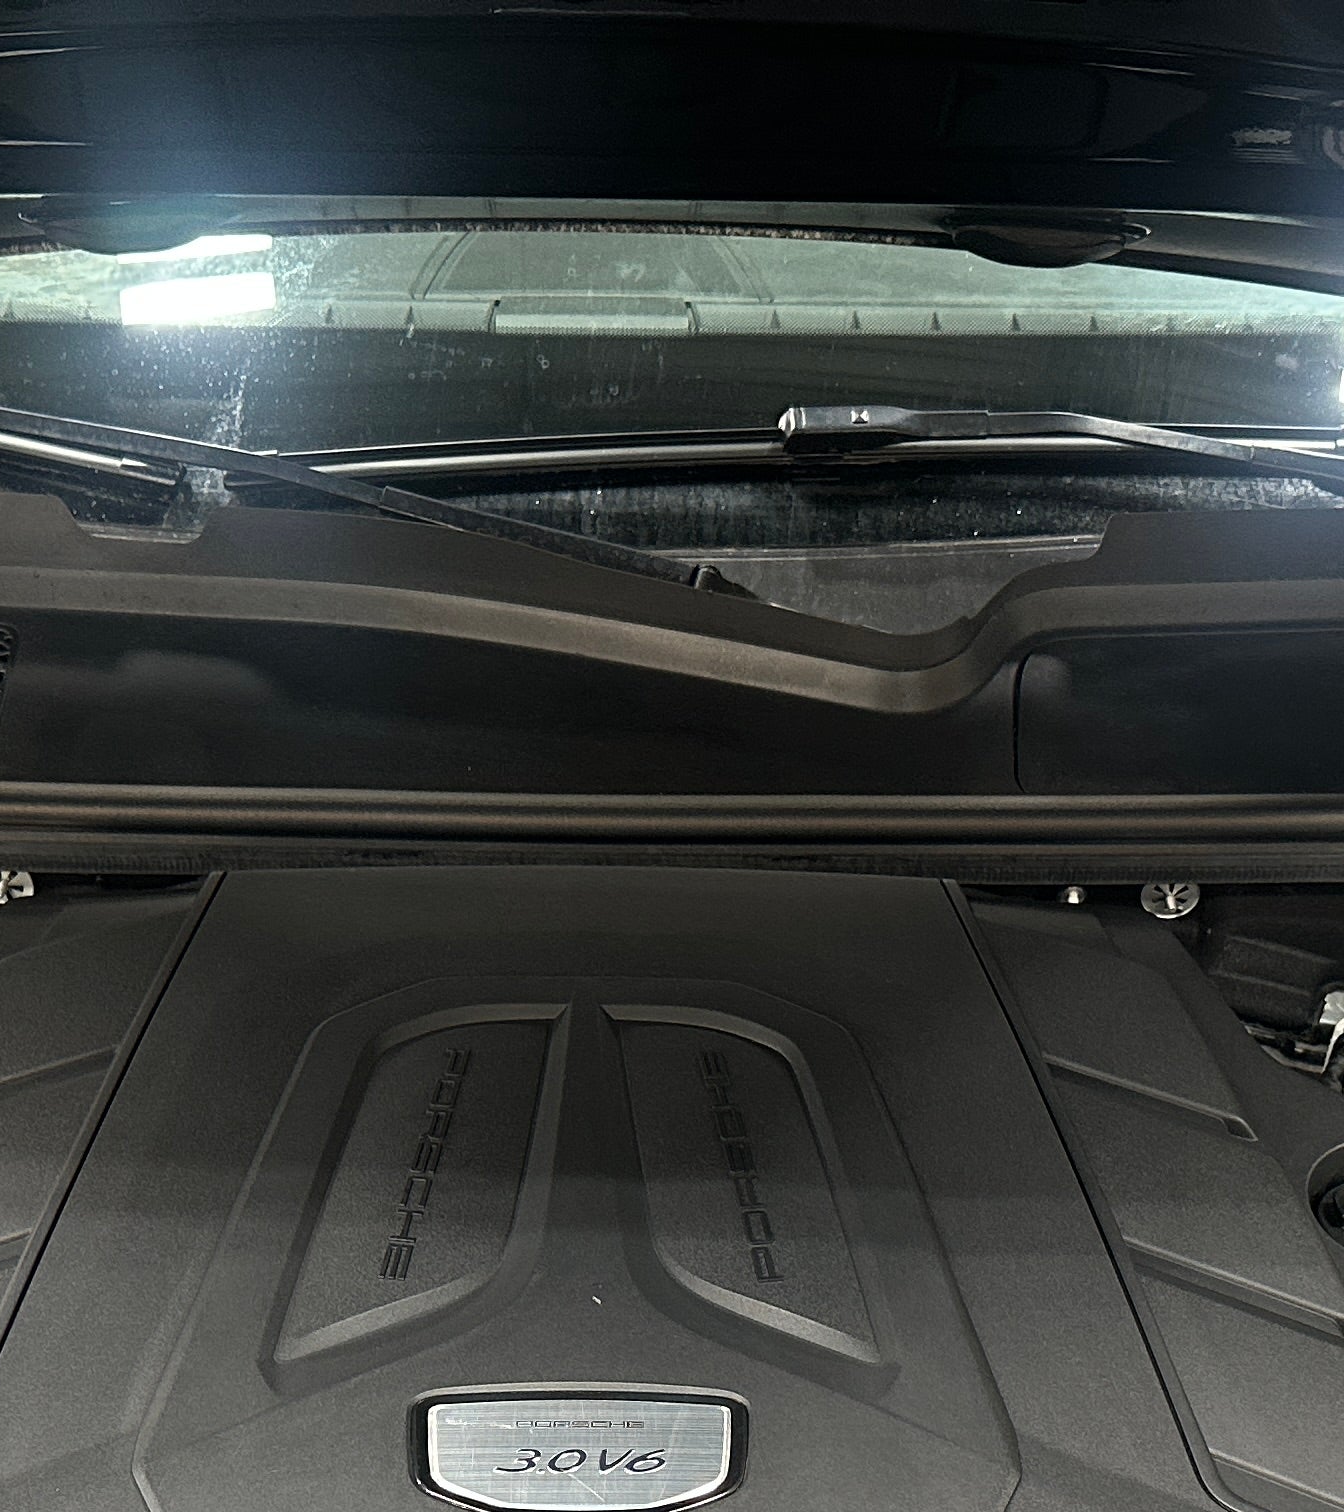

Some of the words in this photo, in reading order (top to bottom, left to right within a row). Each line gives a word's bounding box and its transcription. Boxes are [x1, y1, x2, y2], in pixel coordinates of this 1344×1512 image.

[380, 1047, 472, 1281] PORSCHE
[696, 1050, 784, 1283] PORSCHE
[514, 1420, 645, 1430] PORSCHE
